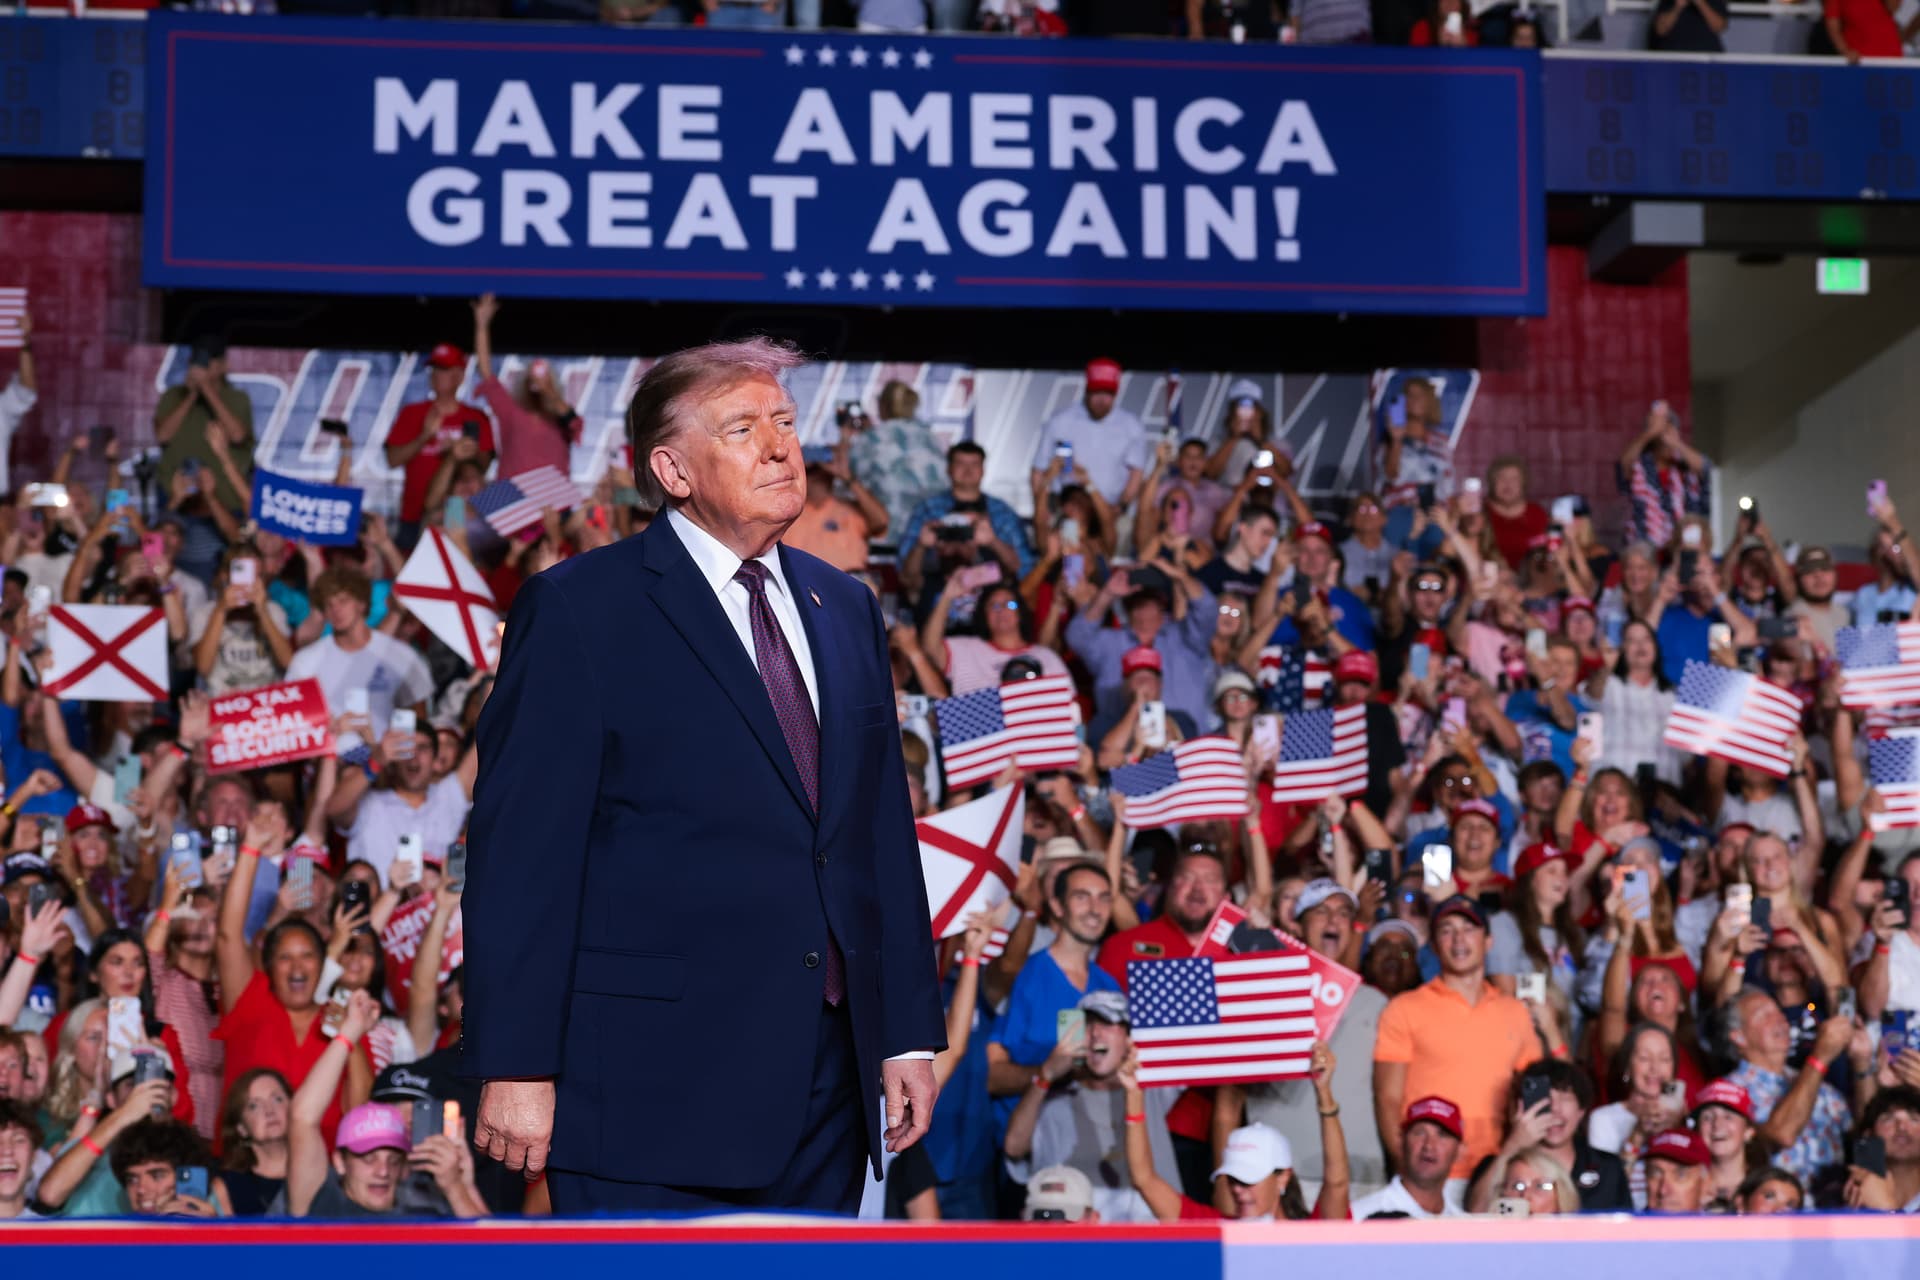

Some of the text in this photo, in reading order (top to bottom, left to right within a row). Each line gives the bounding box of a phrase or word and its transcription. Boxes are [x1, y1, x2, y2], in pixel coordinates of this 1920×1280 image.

[373, 77, 1336, 175] MAKE AMERICA
[406, 166, 1300, 261] GREAT AGAIN!
[260, 502, 347, 534] PRICES
[262, 484, 352, 519] LOWER
[214, 686, 303, 715] NO TAX
[223, 711, 312, 742] SOCIAL
[211, 725, 326, 764] SECURITY
